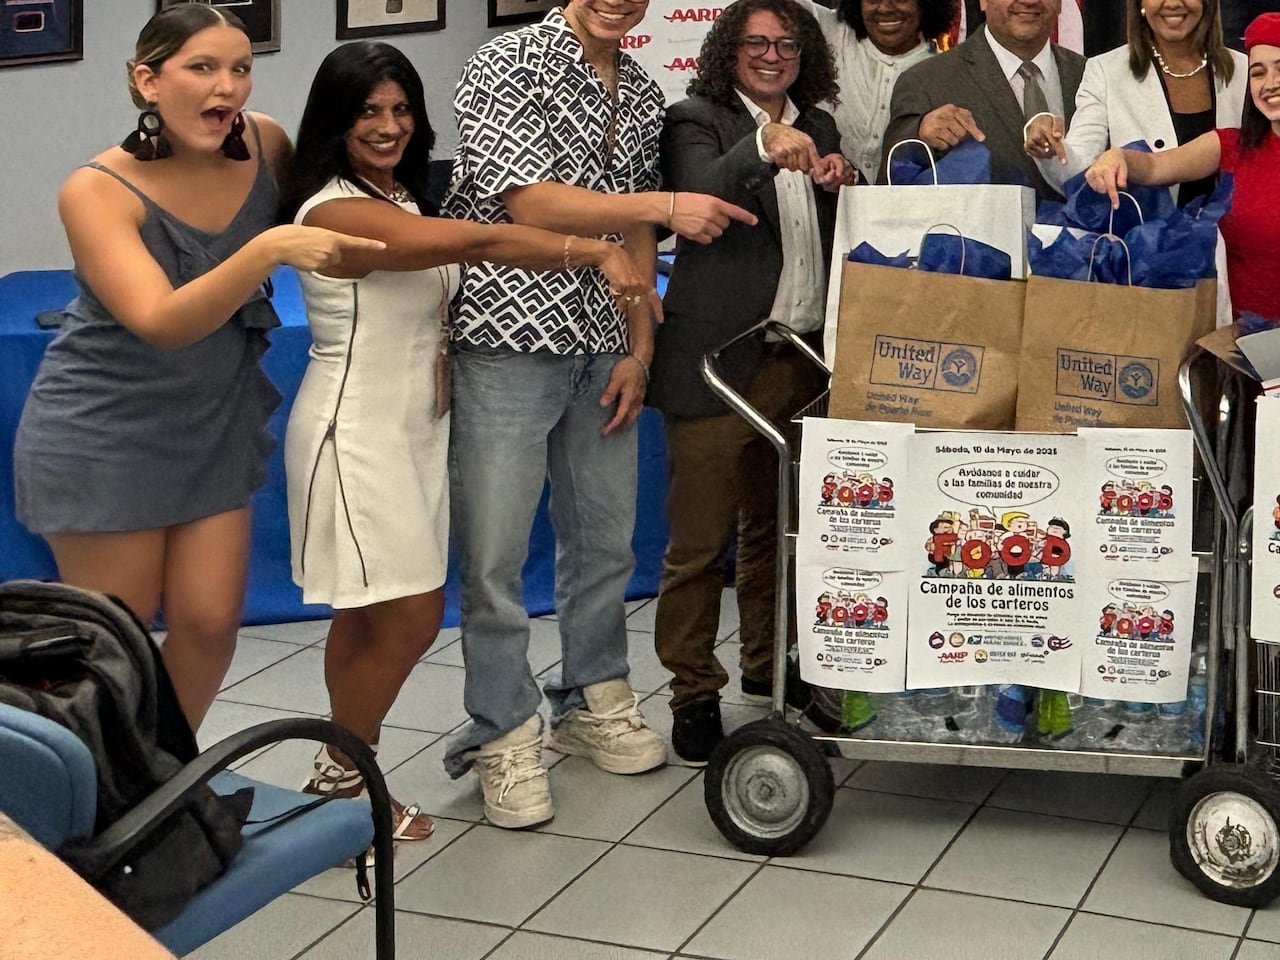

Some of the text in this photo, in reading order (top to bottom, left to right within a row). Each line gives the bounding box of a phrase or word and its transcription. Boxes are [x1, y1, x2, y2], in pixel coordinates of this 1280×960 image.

[664, 58, 697, 70] AA
[878, 342, 936, 363] United
[898, 361, 932, 385] Way
[1060, 354, 1113, 375] United
[1080, 374, 1112, 396] Way
[997, 447, 1021, 456] Mayo
[959, 468, 1002, 477] Ayúdanos
[1013, 470, 1040, 478] cuidar
[968, 479, 1002, 488] familias
[1005, 480, 1015, 488] de
[1018, 481, 1052, 489] nuestra
[976, 491, 1022, 499] comunidad
[932, 533, 1071, 569] FOOD
[920, 580, 1074, 599] Campaña de alimentos
[945, 595, 1048, 611] de los carteros
